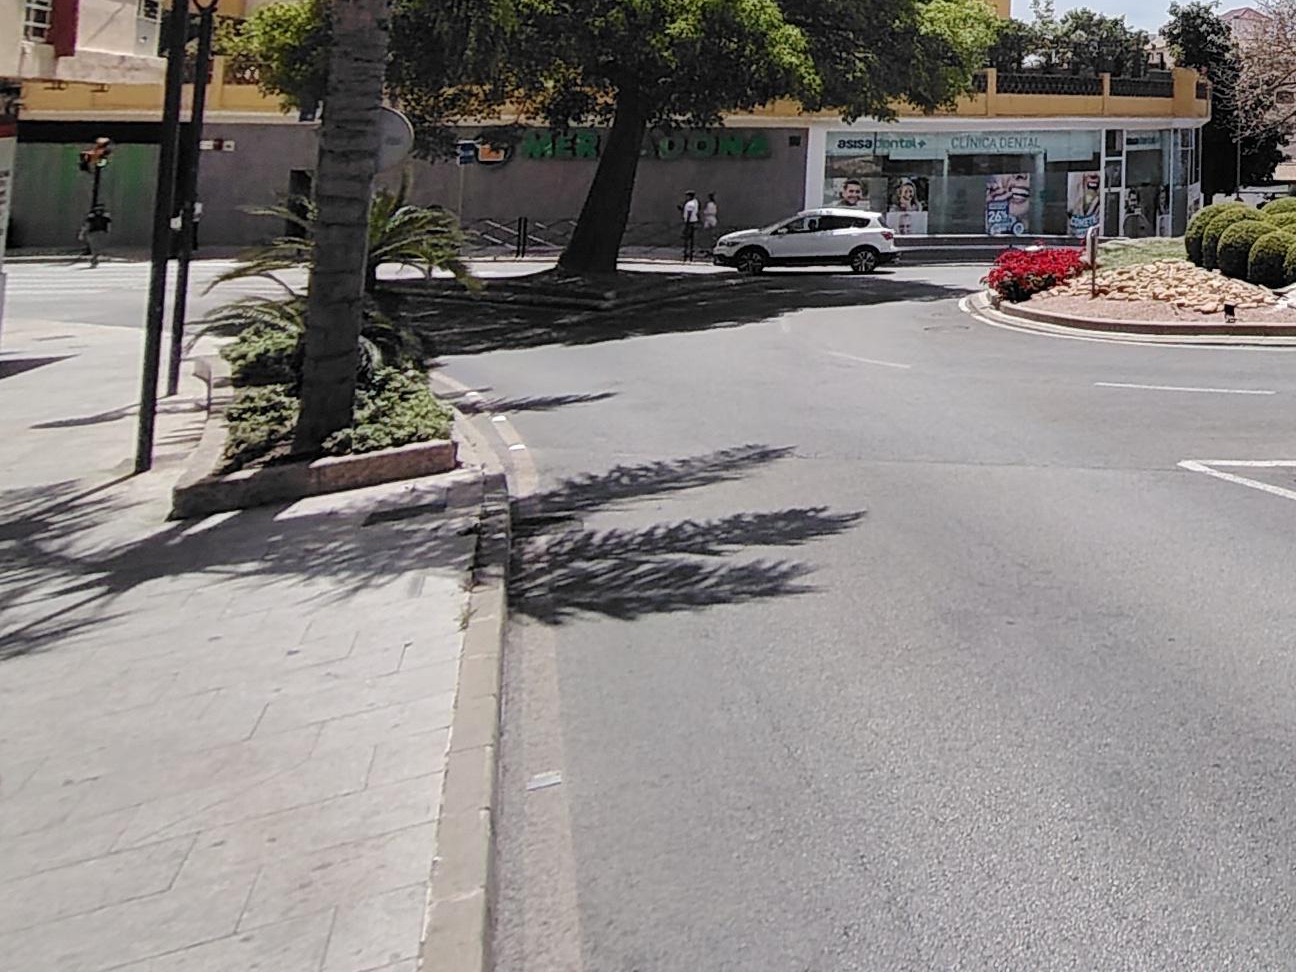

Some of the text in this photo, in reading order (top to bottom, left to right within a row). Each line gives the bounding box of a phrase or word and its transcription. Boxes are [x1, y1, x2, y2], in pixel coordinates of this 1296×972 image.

[521, 131, 771, 159] MERDONA
[951, 135, 1041, 149] CLÍNICA DENTAL
